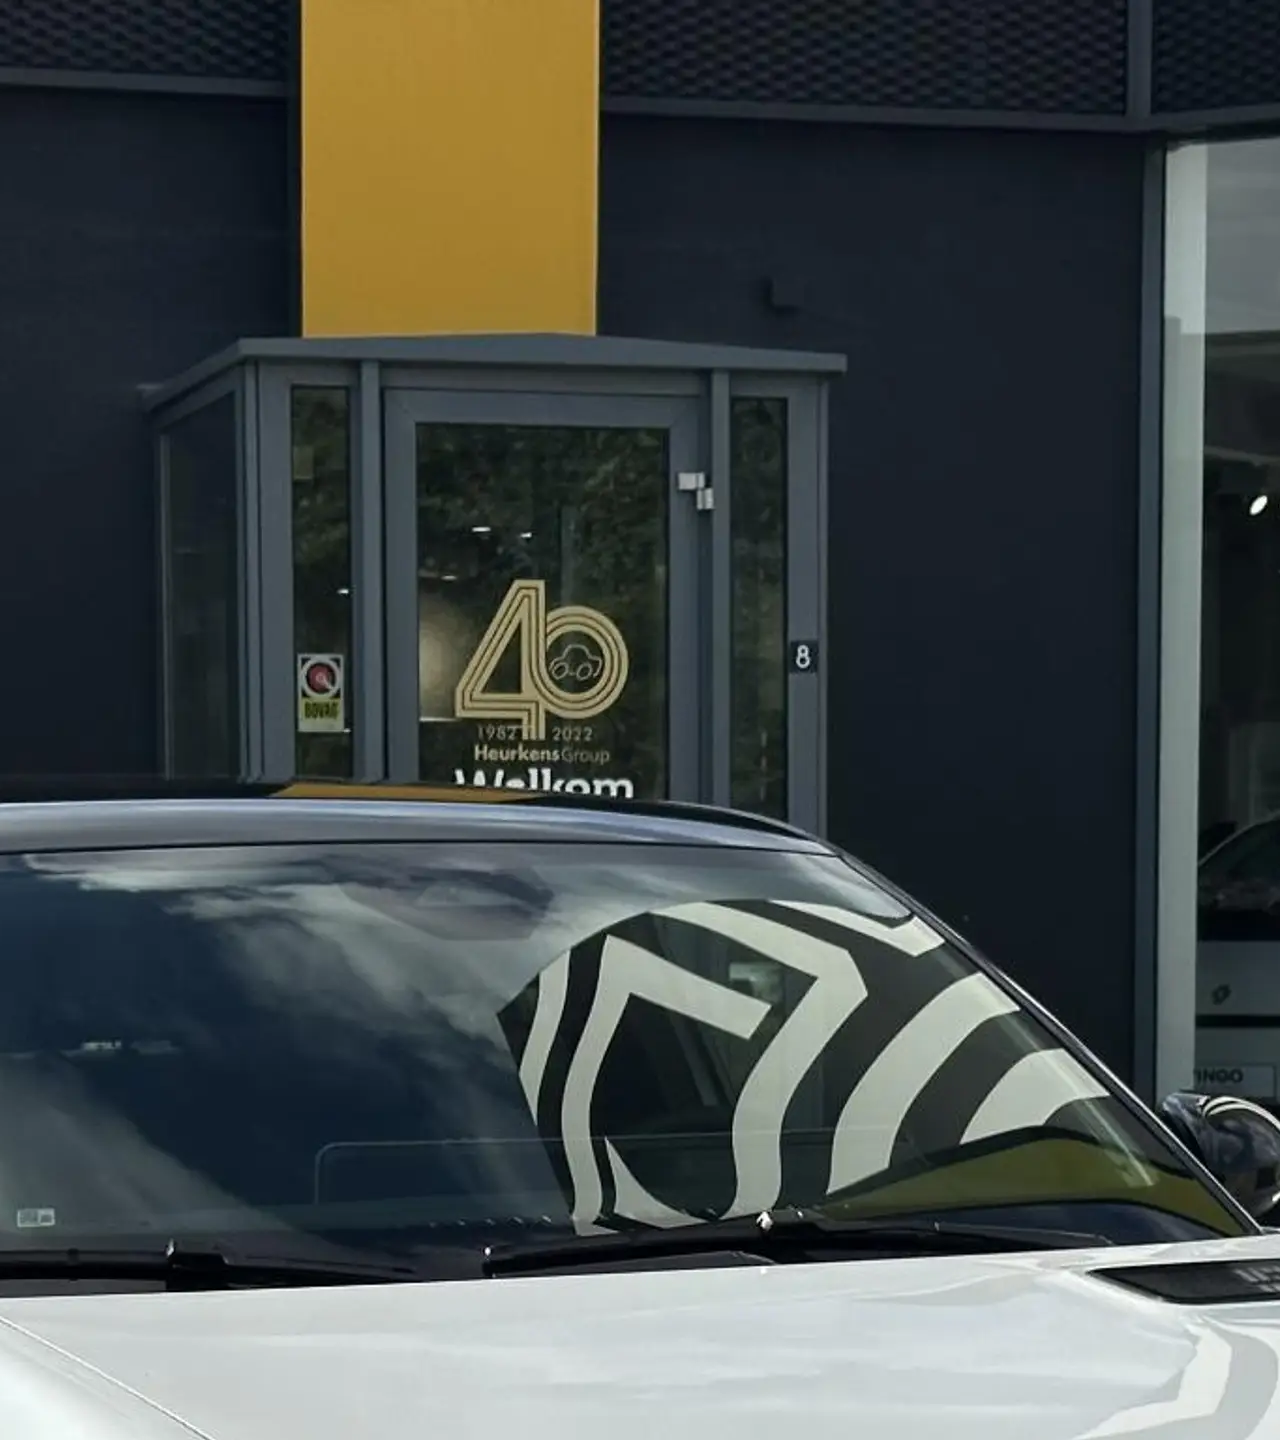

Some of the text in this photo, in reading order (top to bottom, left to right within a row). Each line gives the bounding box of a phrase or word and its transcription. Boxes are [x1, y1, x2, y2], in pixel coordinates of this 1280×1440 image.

[455, 579, 629, 740] 40
[795, 644, 811, 669] 8
[478, 724, 593, 741] 1982 2022
